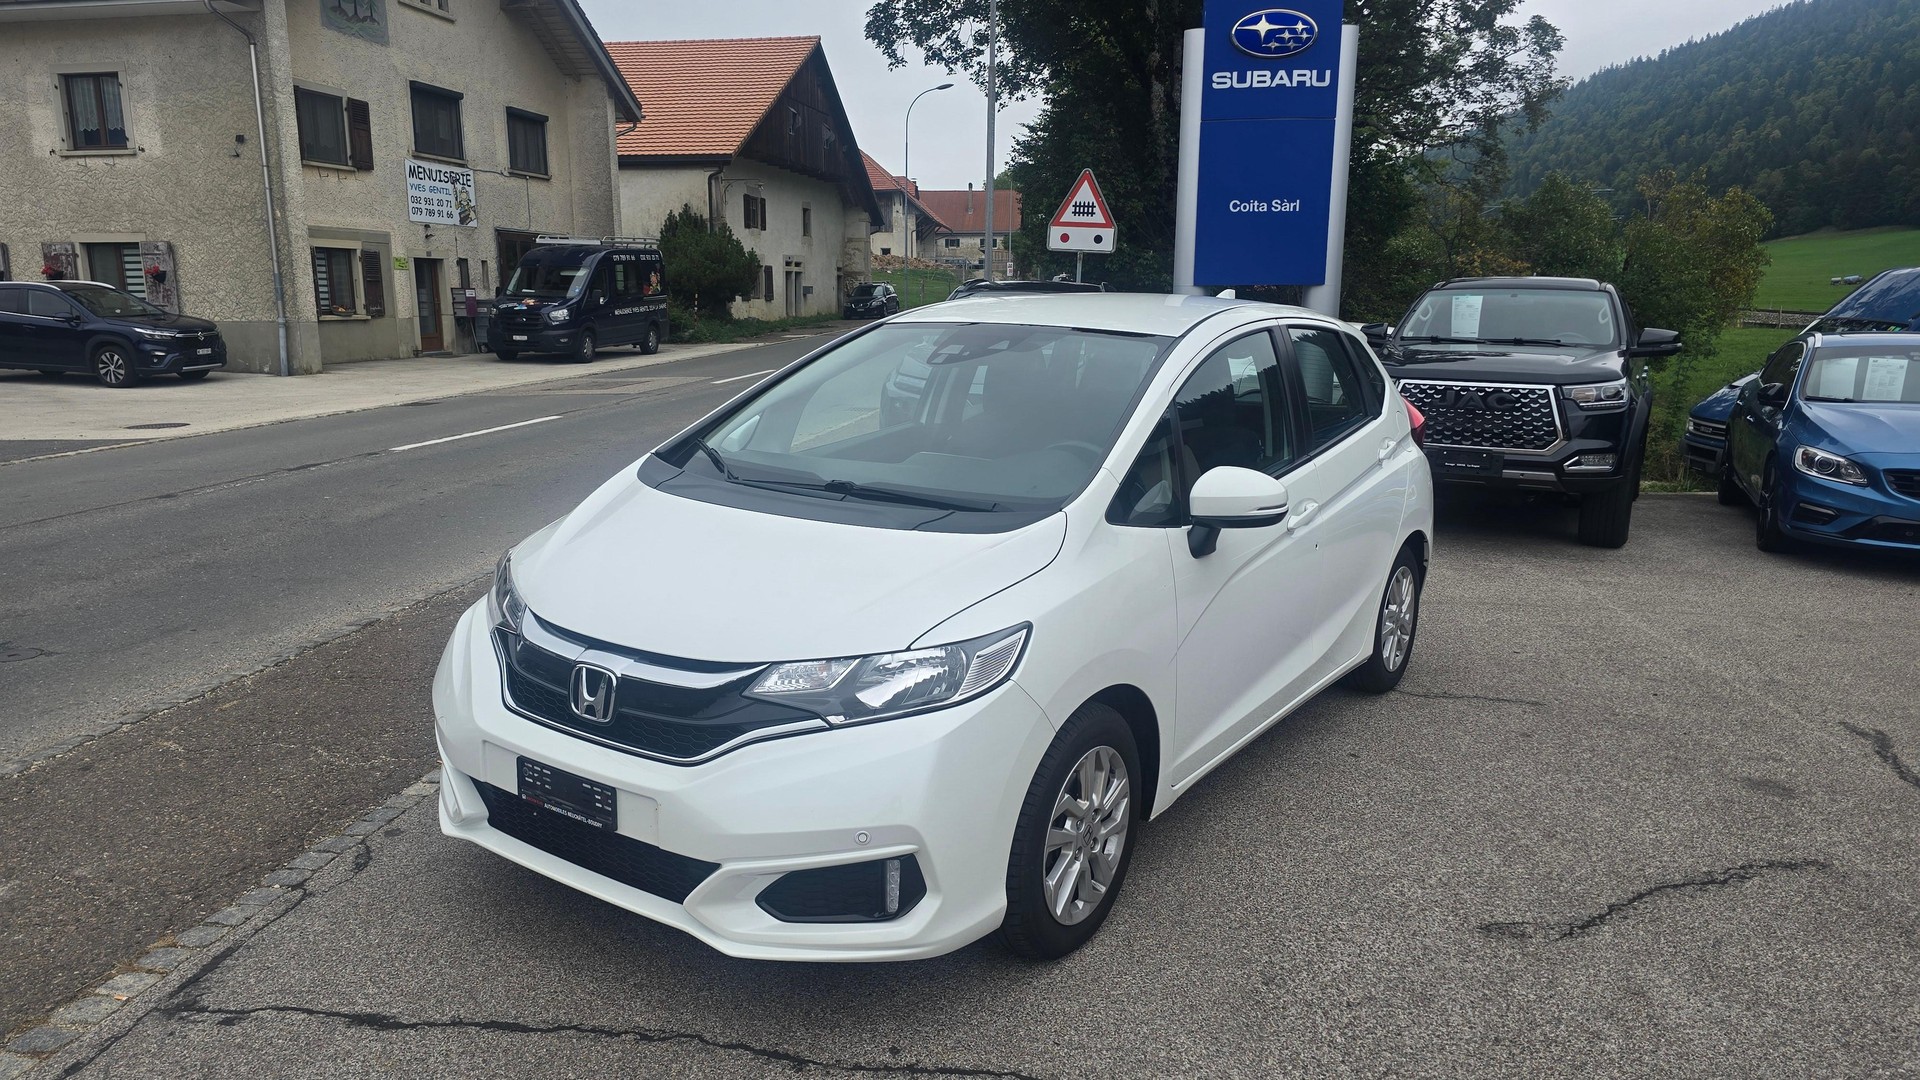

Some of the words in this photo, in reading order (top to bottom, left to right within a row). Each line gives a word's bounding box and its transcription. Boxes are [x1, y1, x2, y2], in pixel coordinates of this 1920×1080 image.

[1212, 69, 1331, 89] SUBARU
[408, 165, 472, 188] MENUISERIE
[409, 183, 426, 193] YVES
[429, 185, 452, 196] GENTIL
[410, 195, 422, 205] 032
[424, 197, 434, 206] 931
[436, 199, 444, 207] 20
[445, 199, 452, 208] 71
[1229, 199, 1267, 213] Coita
[1271, 198, 1300, 212] Sàrl
[411, 206, 423, 216] 079
[425, 208, 436, 217] 789
[437, 209, 444, 218] 91
[446, 210, 454, 219] 66
[1434, 389, 1517, 410] JAC
